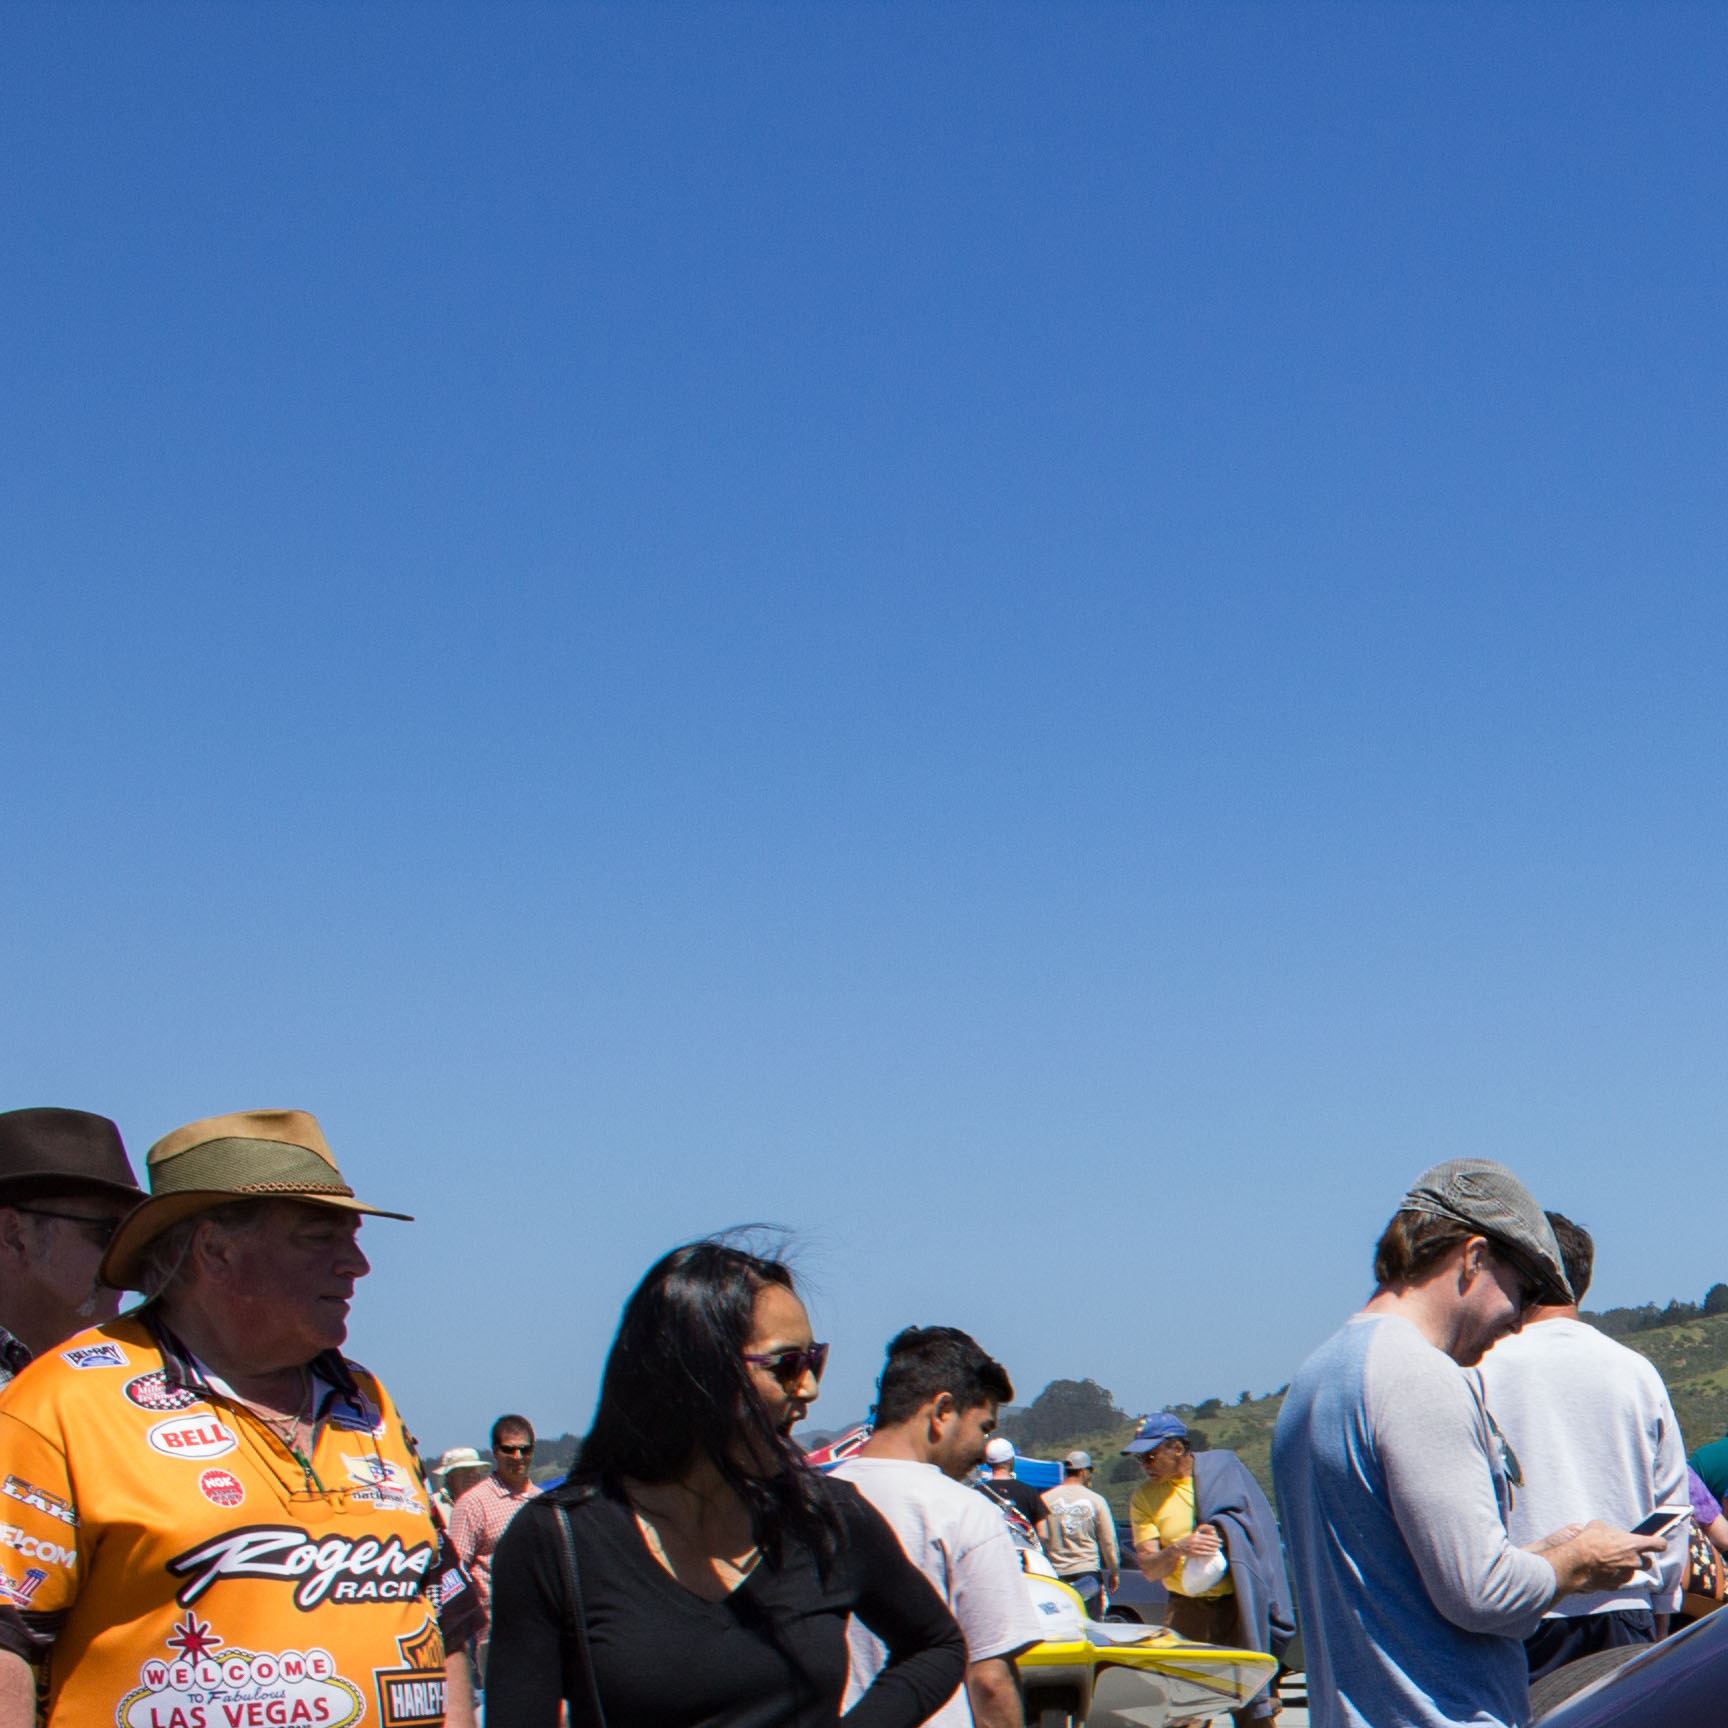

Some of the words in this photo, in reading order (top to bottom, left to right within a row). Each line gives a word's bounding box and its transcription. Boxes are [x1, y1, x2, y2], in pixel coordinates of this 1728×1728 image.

[161, 1424, 230, 1449] BELL
[205, 1477, 235, 1489] NGK
[176, 1531, 432, 1606] Rogers
[147, 1659, 328, 1685] WELCOME
[187, 1693, 204, 1704] TO
[208, 1687, 286, 1704] Fabulous
[223, 1697, 330, 1728] VEGAS
